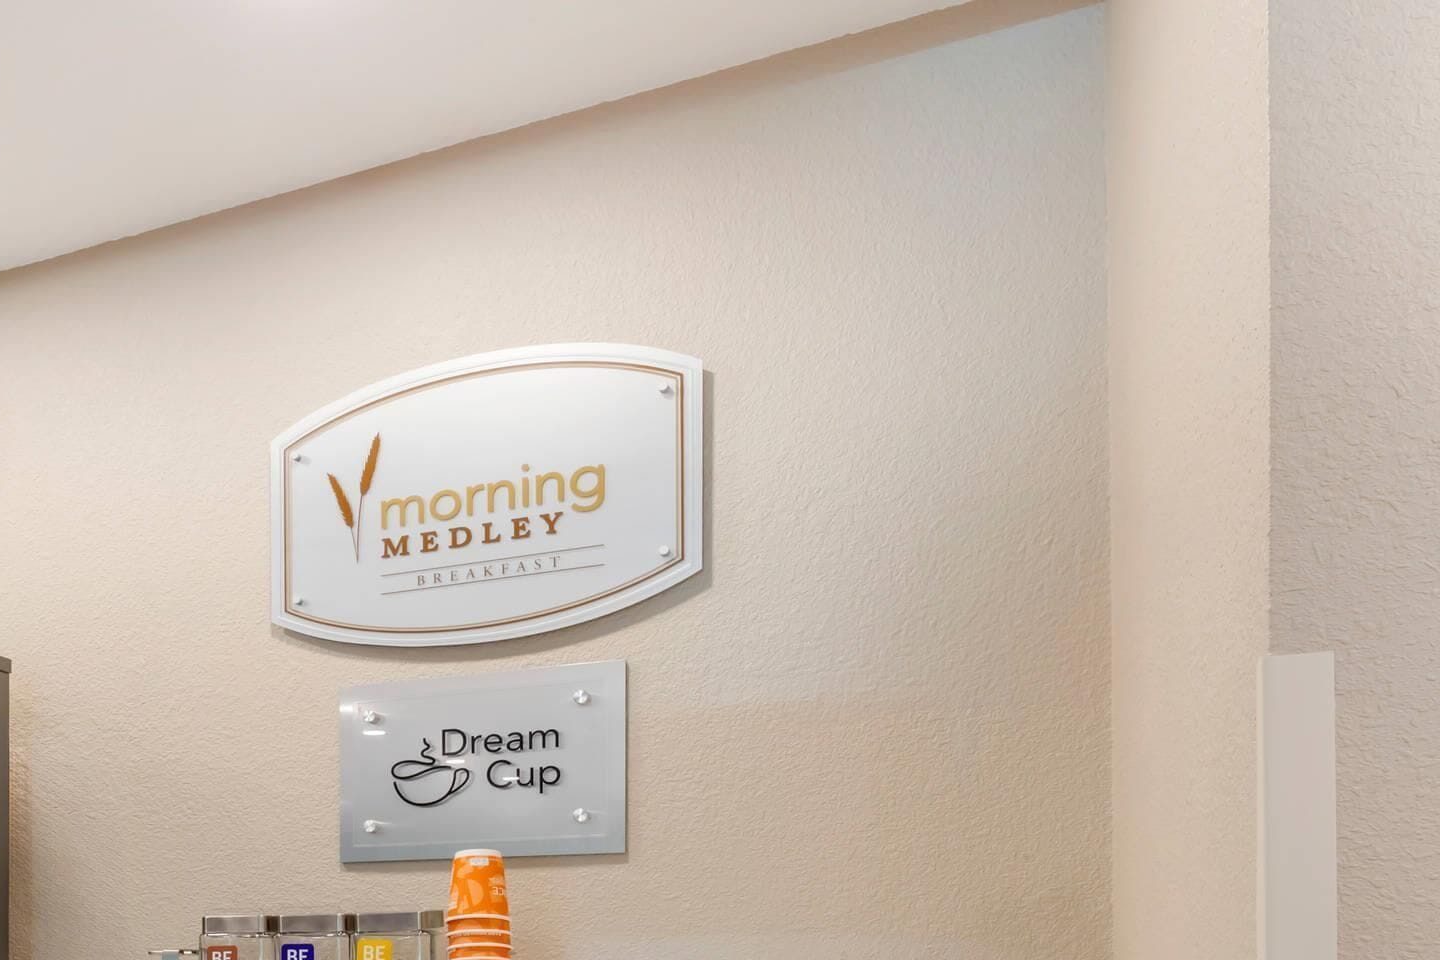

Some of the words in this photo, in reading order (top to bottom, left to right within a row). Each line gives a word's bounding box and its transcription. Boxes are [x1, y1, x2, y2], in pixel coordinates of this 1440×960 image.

[380, 463, 606, 530] morning
[381, 512, 565, 559] MEDLEY
[417, 556, 563, 587] BREAKFAST
[441, 728, 560, 757] Dream
[486, 760, 561, 794] Cup
[363, 945, 385, 960] BE
